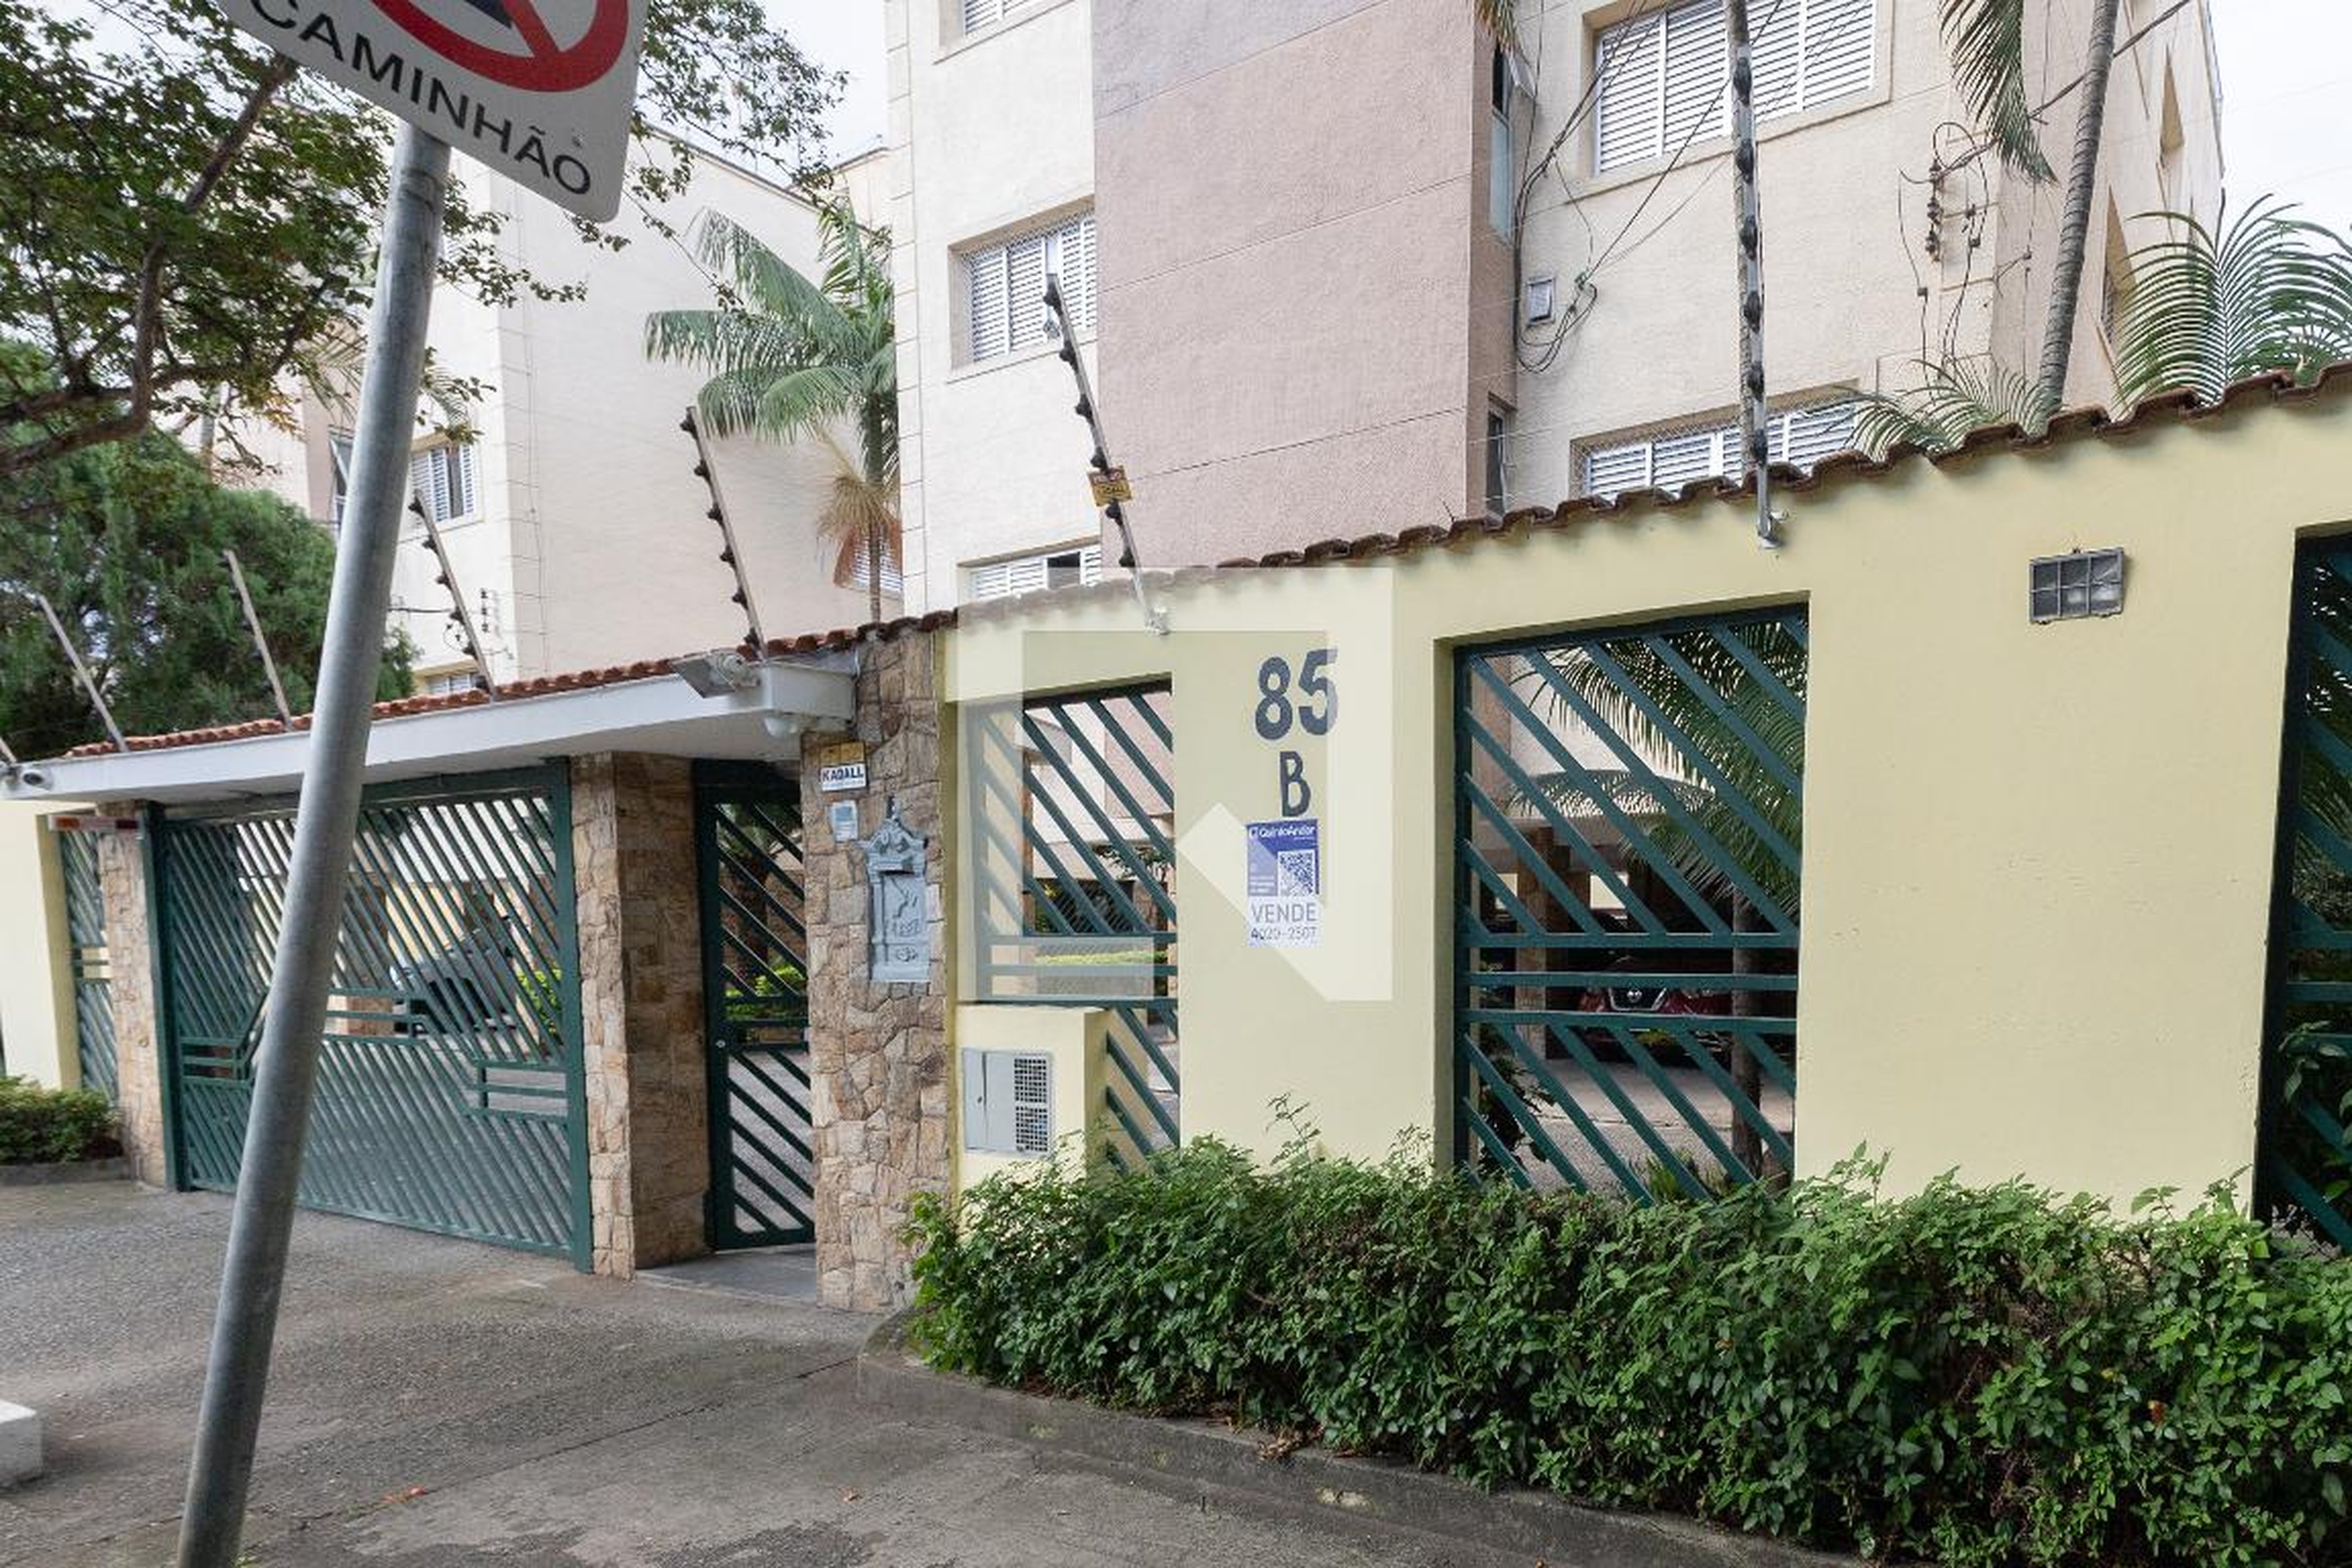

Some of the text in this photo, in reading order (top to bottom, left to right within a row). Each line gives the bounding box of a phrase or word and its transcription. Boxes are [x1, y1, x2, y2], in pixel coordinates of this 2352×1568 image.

[1255, 649, 1338, 740] 85
[1280, 751, 1311, 816] B
[1251, 903, 1317, 922] VENDE
